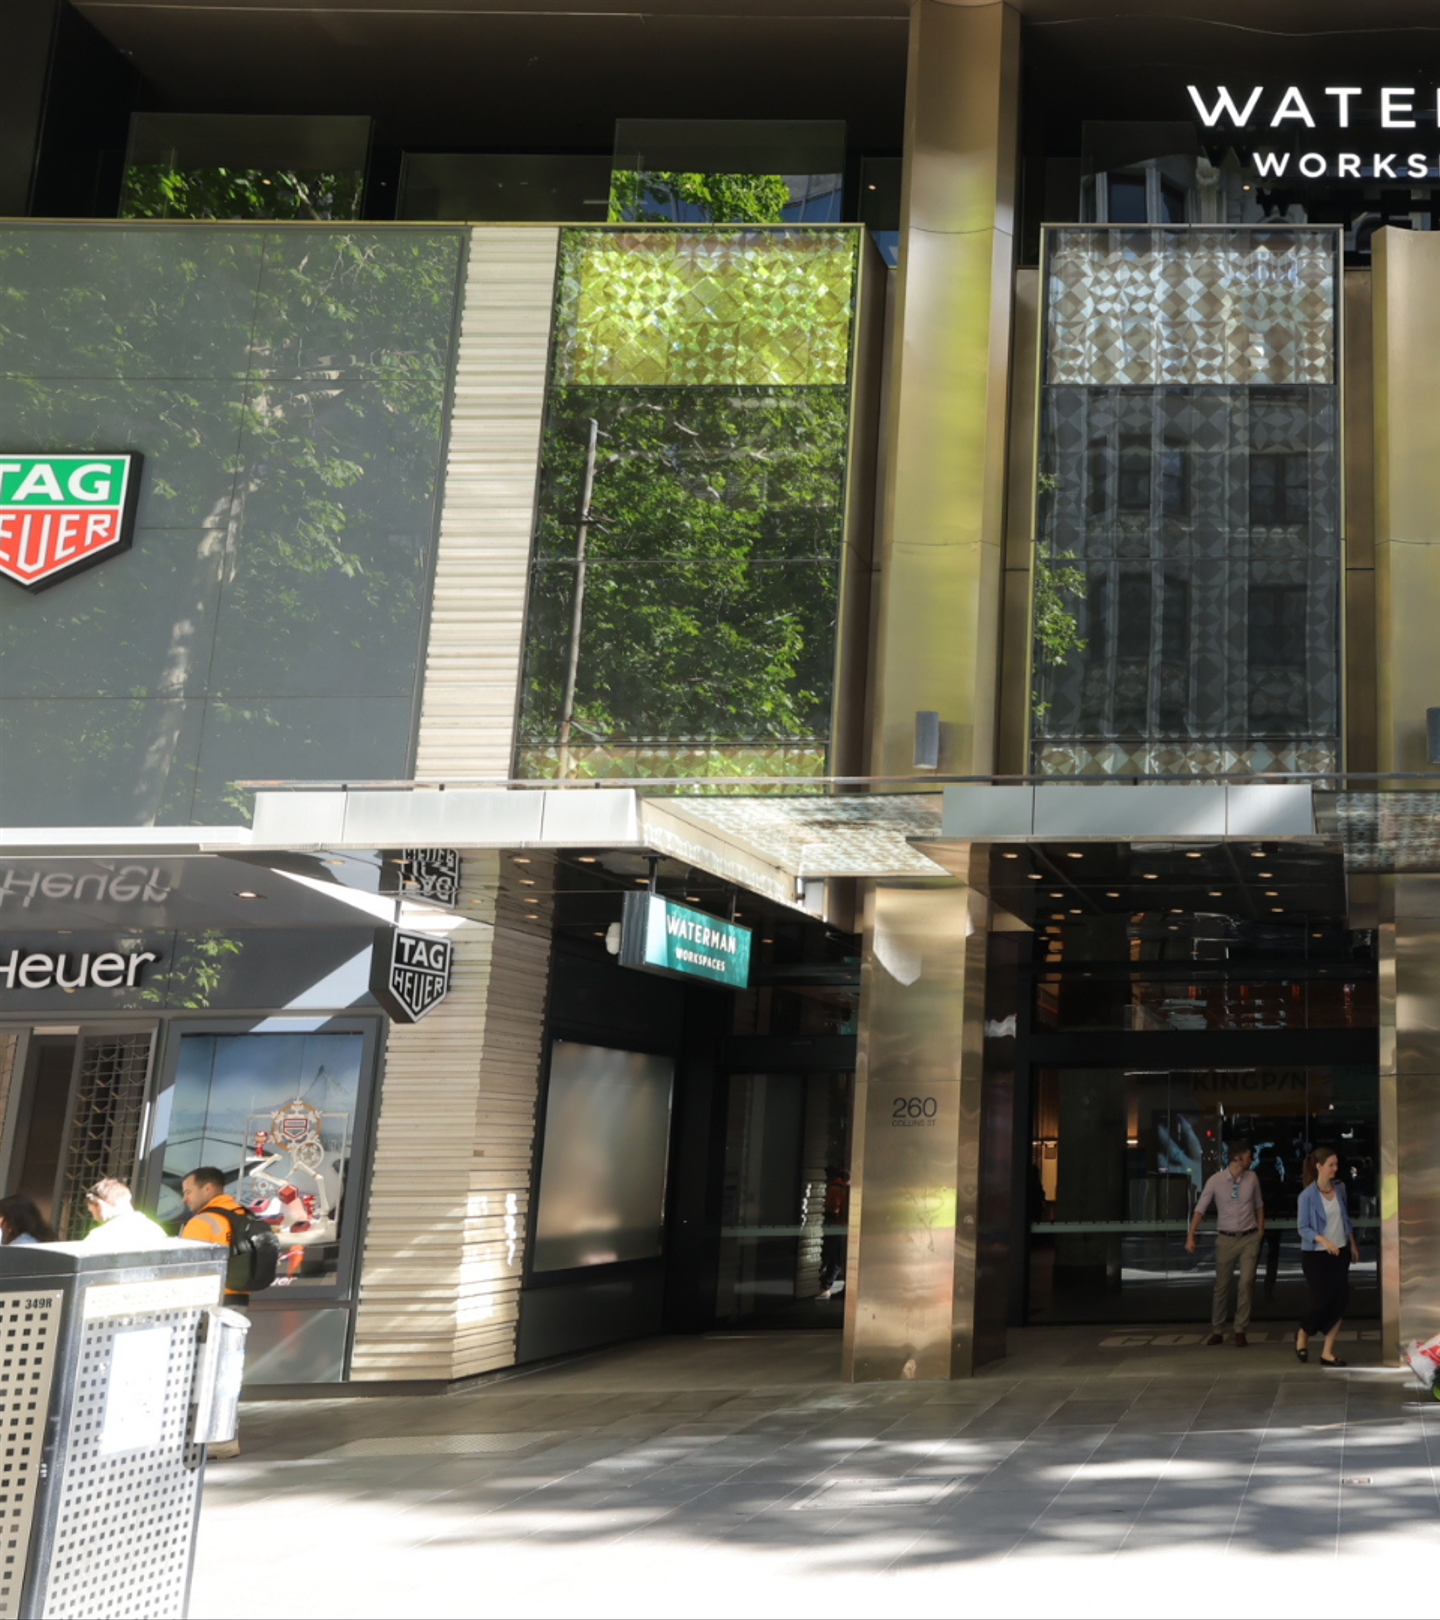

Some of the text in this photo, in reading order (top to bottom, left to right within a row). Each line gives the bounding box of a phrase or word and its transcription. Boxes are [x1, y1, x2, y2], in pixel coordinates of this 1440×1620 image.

[0, 463, 112, 502] TAG
[0, 514, 112, 574] EUER
[666, 914, 738, 955] WATERMAN
[399, 936, 445, 970] TAG
[675, 947, 726, 972] WORKSPACES
[393, 969, 445, 1013] HEUER
[892, 1097, 938, 1118] 260
[25, 1298, 53, 1309] 349R
